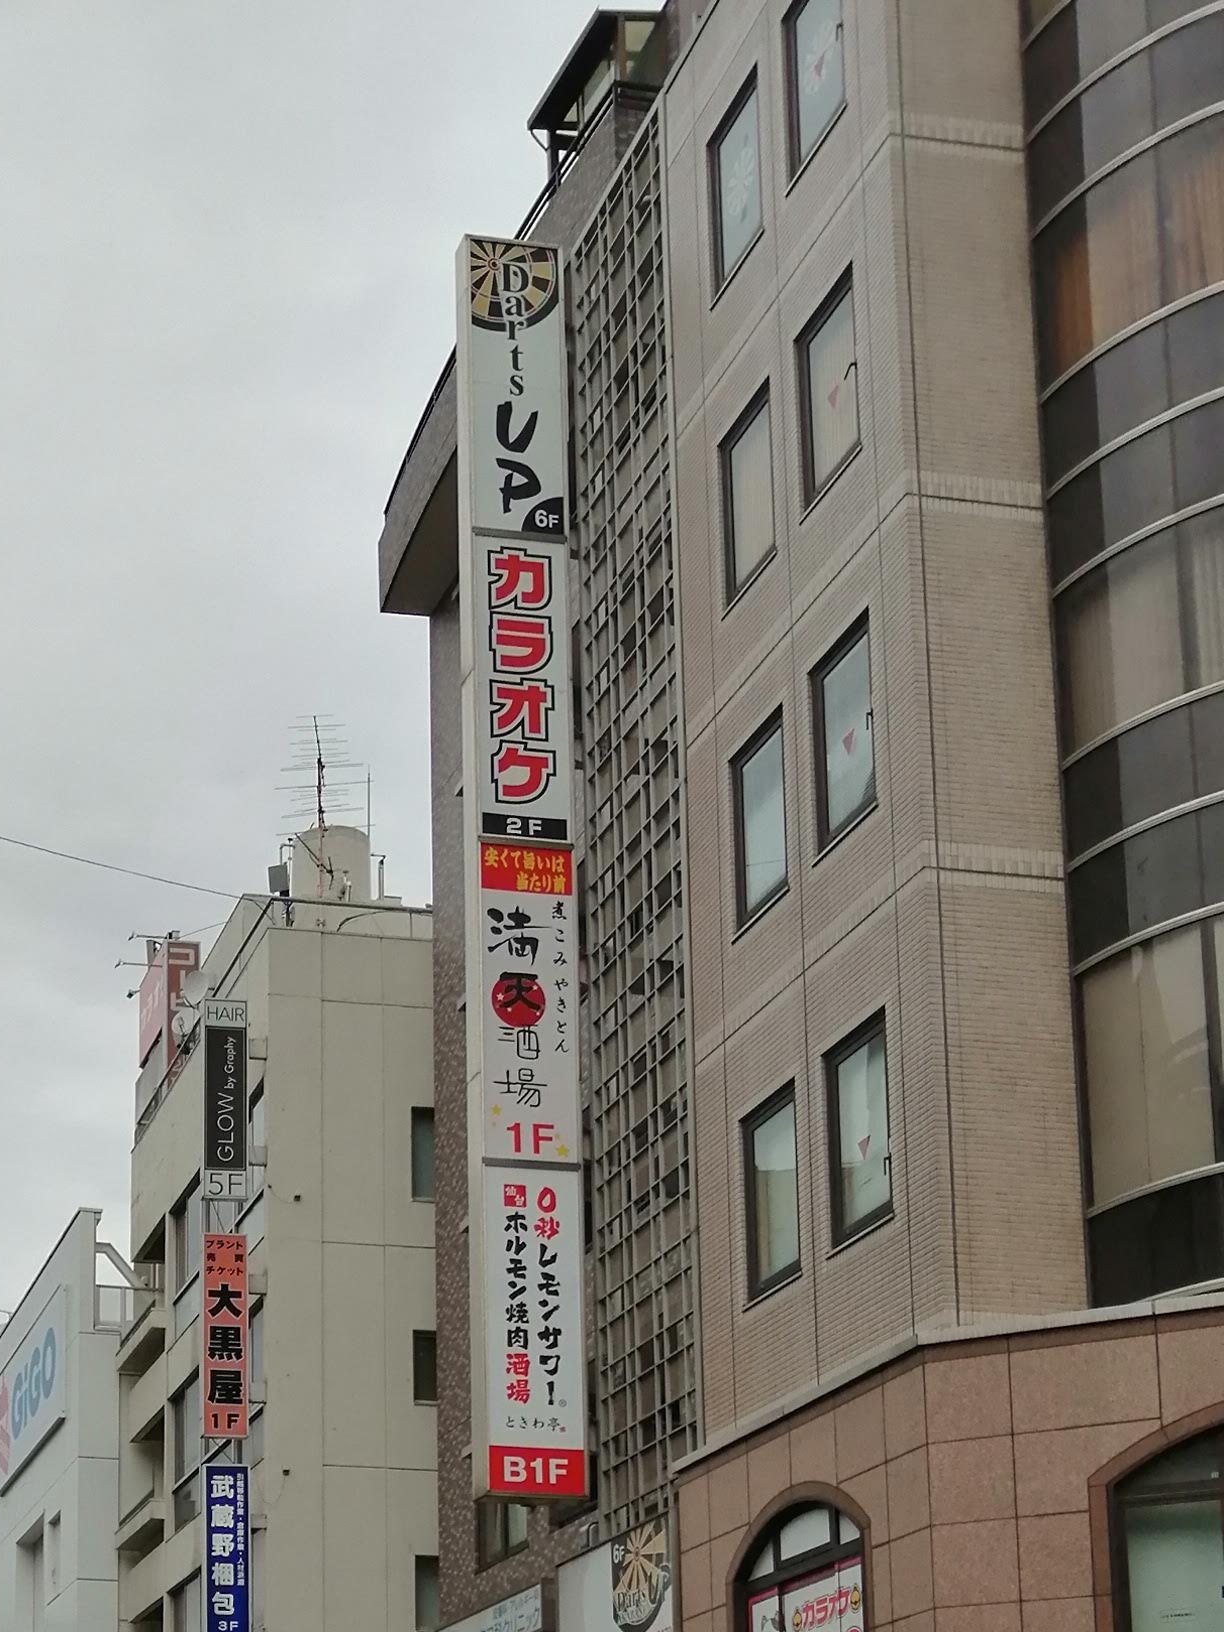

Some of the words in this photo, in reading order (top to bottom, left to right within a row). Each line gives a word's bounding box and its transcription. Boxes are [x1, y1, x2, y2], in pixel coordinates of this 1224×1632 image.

[502, 263, 529, 396] Darts
[496, 401, 542, 514] UP
[535, 509, 559, 528] 6F
[489, 547, 556, 804] カラオケ
[506, 817, 542, 835] 2F
[484, 846, 564, 872] 安くて旨いは
[516, 871, 566, 893] 当たり前
[207, 1006, 244, 1021] HAIR
[224, 1036, 236, 1074] Graphy
[224, 1076, 236, 1089] by
[217, 1093, 234, 1161] GLOW
[506, 1123, 554, 1154] 1F
[208, 1173, 243, 1196] 5F
[206, 1266, 243, 1276] チケット
[208, 1283, 243, 1404] 大黒屋
[211, 1413, 240, 1429] 1F
[506, 1416, 560, 1432] ときわ亭
[503, 1456, 568, 1485] B1F
[211, 1474, 235, 1616] 武蔵野梱包
[613, 1544, 625, 1563] 6F
[801, 1588, 851, 1630] カラオケ
[218, 1620, 239, 1631] 3F
